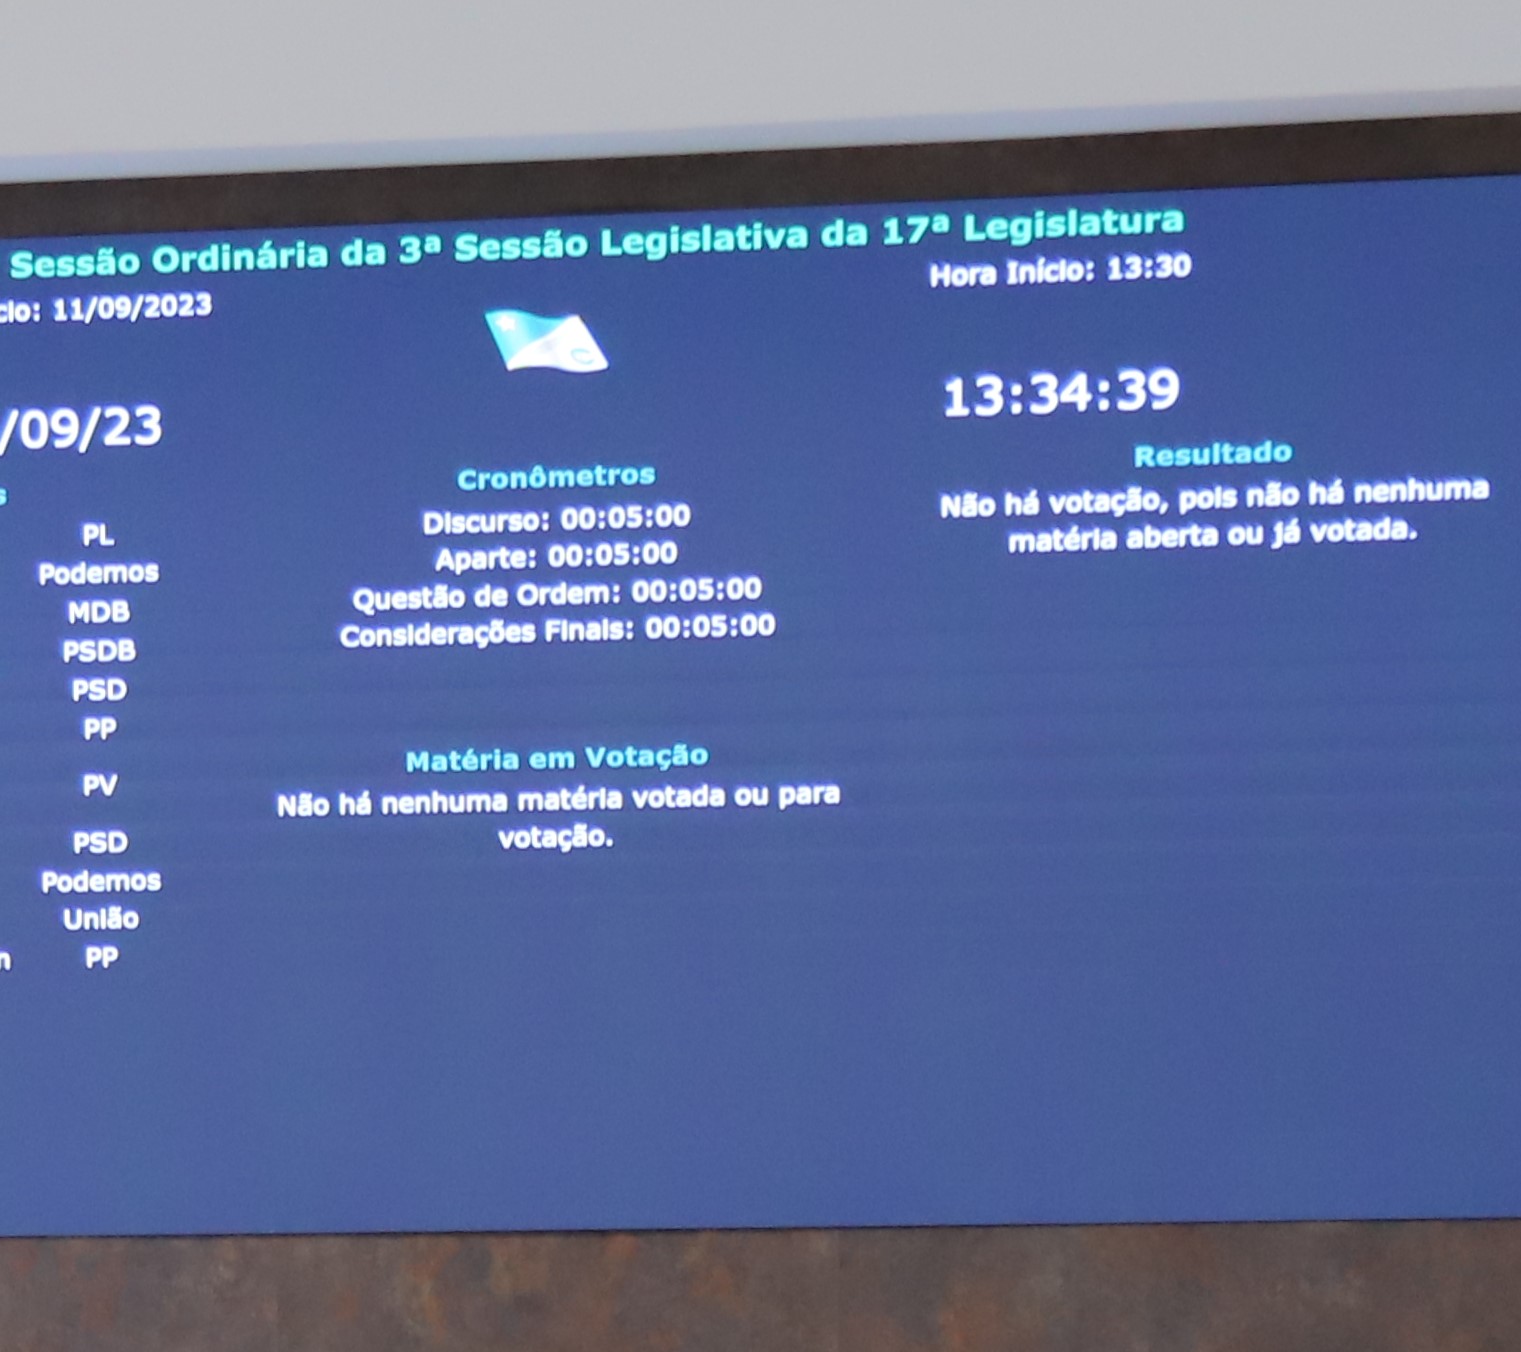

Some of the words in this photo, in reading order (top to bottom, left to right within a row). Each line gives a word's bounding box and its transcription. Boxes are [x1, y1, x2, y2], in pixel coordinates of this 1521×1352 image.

[9, 245, 142, 280] Sessão
[150, 238, 330, 275] Ordinária
[339, 236, 388, 268] da
[397, 233, 443, 265] 3ª
[453, 227, 590, 263] Sessão
[599, 220, 810, 262] Legislativa
[819, 216, 869, 249] da
[881, 212, 952, 248] 17ª
[962, 207, 1186, 248] Legislatura
[928, 262, 999, 289] Hora
[1005, 255, 1096, 286] Início:
[1107, 251, 1194, 282] 13:30
[52, 290, 214, 325] 11/09/2023
[943, 365, 1181, 418] 13:34:39
[1133, 438, 1294, 469] Resultado
[456, 463, 657, 492] Cronômetros
[938, 490, 998, 520] Não
[1002, 487, 1041, 518] há
[1047, 484, 1170, 519] votação,
[1177, 484, 1239, 516] pois
[1244, 479, 1302, 509] não
[1307, 476, 1346, 507] há
[1352, 475, 1491, 505] nenhuma
[80, 521, 116, 548] PL
[421, 509, 551, 537] Discurso:
[558, 501, 693, 532] 00:05:00
[1007, 523, 1119, 555] matéria
[1124, 522, 1221, 551] aberta
[1225, 523, 1265, 547] ou
[1269, 516, 1303, 551] já
[1308, 514, 1419, 544] votada.
[37, 559, 161, 587] Podemos
[433, 544, 538, 577] Aparte:
[546, 538, 680, 569] 00:05:00
[66, 597, 132, 626] MDB
[351, 582, 467, 617] Questão
[472, 582, 510, 609] de
[514, 579, 622, 608] Ordem:
[629, 574, 764, 604] 00:05:00
[338, 617, 538, 650] Considerações
[543, 616, 635, 644] Finais:
[643, 611, 778, 641] 00:05:00
[61, 636, 138, 664] PSDB
[70, 676, 129, 703] PSD
[81, 715, 119, 742] PP
[405, 746, 521, 774] Matéria
[527, 749, 576, 771] em
[583, 741, 710, 773] Votação
[81, 772, 120, 798] PV
[275, 790, 332, 819] Não
[337, 788, 373, 817] há
[379, 788, 510, 816] nenhuma
[516, 783, 625, 813] matéria
[630, 782, 727, 810] votada
[732, 785, 770, 808] ou
[777, 782, 842, 812] para
[71, 828, 130, 856] PSD
[496, 820, 615, 854] votação.
[40, 868, 163, 895] Podemos
[61, 903, 141, 932] União
[84, 944, 120, 970] PP
